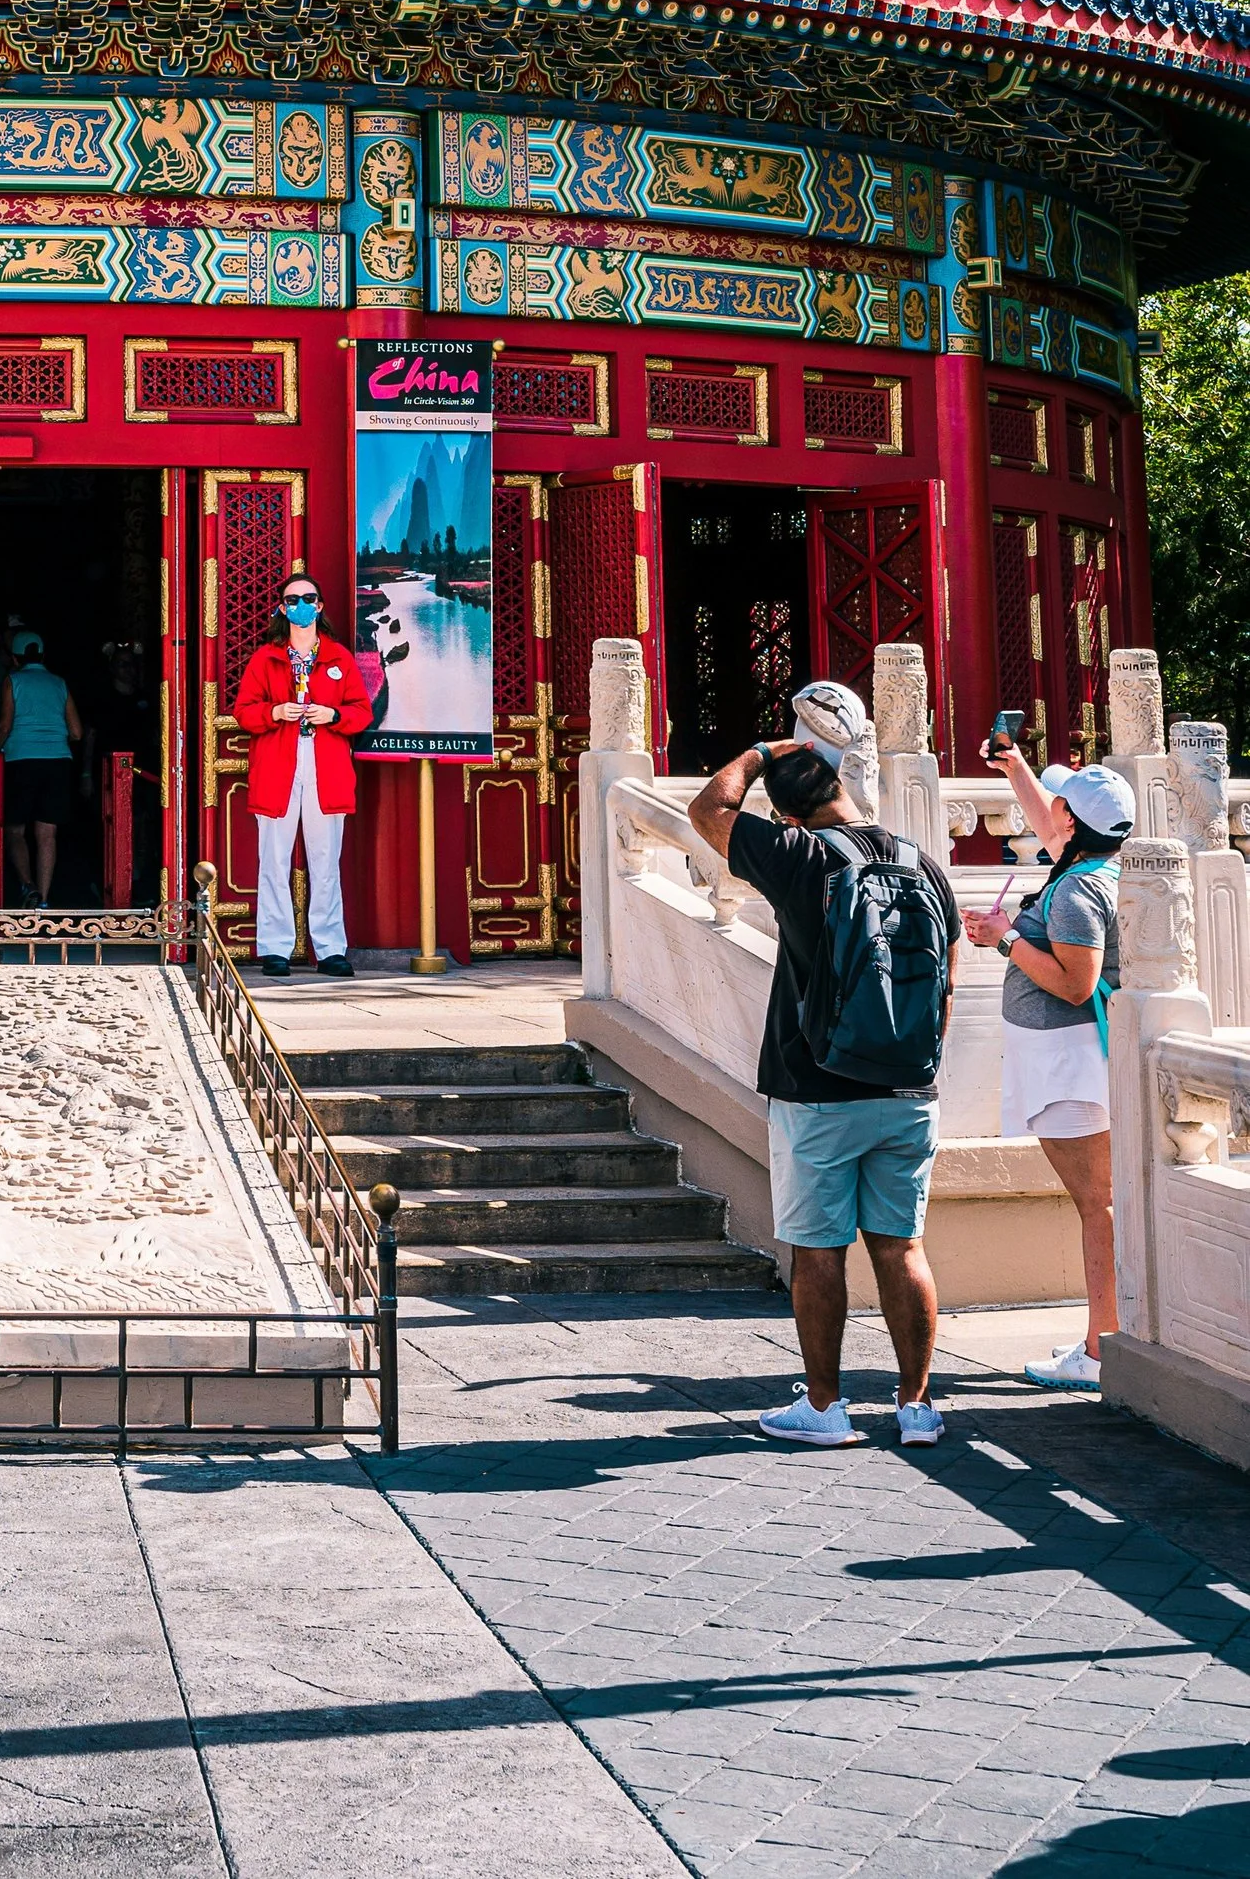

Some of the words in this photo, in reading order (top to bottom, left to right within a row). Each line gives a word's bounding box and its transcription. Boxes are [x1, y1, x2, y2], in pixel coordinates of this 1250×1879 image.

[377, 342, 474, 353] REFLECTIONS
[392, 357, 405, 370] of
[368, 356, 480, 400] China
[403, 396, 412, 405] In
[413, 397, 460, 406] Circle-Vision
[460, 398, 475, 406] 360
[369, 414, 412, 427] Showing
[414, 416, 480, 429] Continuously
[371, 738, 424, 750] AGELESS
[429, 740, 478, 751] BEAUTY
